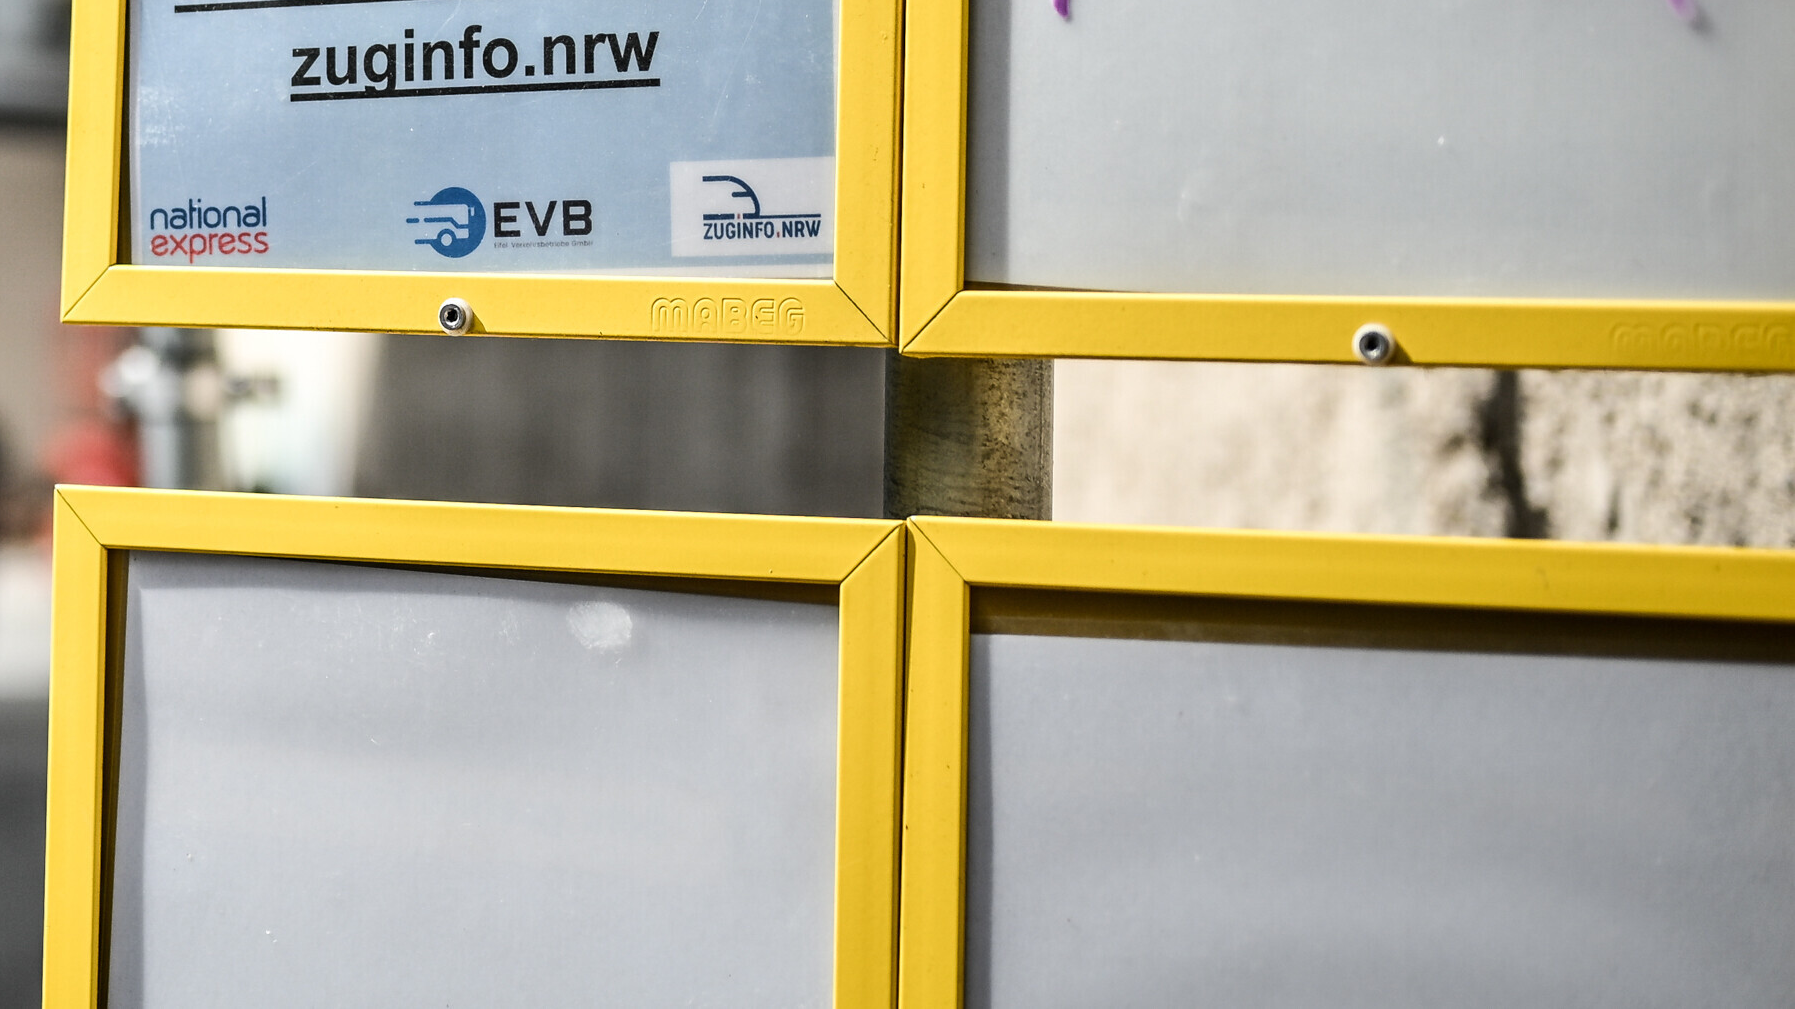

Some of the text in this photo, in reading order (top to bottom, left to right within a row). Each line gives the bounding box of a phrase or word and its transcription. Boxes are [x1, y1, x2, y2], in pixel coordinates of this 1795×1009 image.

[290, 24, 660, 94] zuginfo.nrw
[150, 196, 267, 230] national
[494, 200, 592, 237] EVB
[703, 220, 821, 239] ZUGINFO.NRW
[151, 231, 269, 264] express
[651, 297, 804, 334] MABEG
